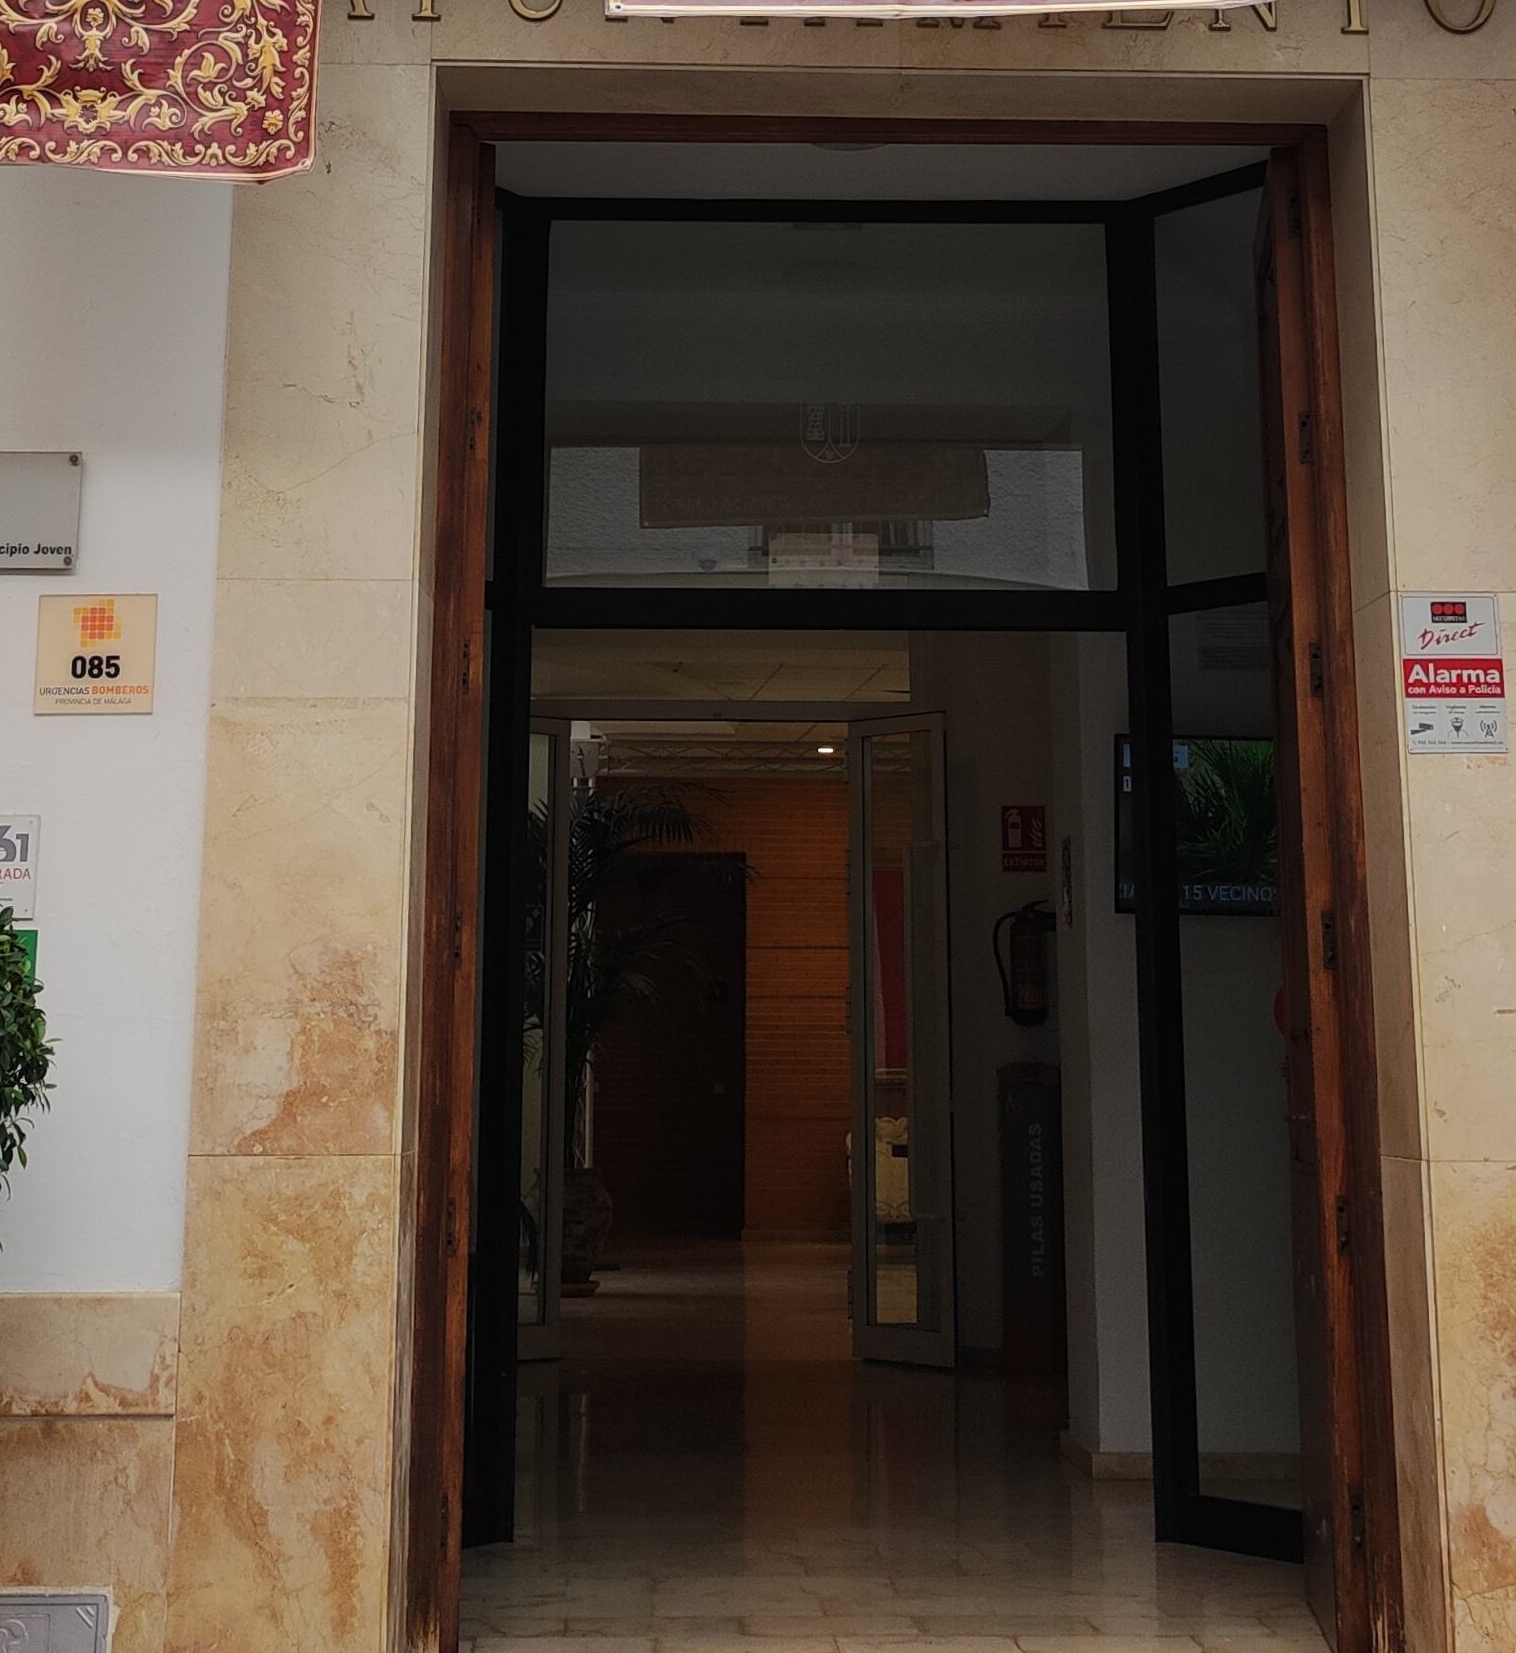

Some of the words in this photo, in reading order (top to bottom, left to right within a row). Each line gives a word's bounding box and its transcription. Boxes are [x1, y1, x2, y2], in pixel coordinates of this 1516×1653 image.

[33, 544, 72, 555] Joven
[1418, 622, 1485, 650] Direct
[71, 655, 121, 679] 085
[1408, 663, 1501, 684] Alarma
[39, 687, 90, 696] URGENCIAS
[92, 686, 149, 695] BOMBEROS
[1408, 686, 1426, 694] con
[1429, 685, 1457, 694] Aviso
[1205, 885, 1276, 901] VECINO
[1027, 1123, 1044, 1207] USADAS
[1031, 1216, 1044, 1277] PILAS
